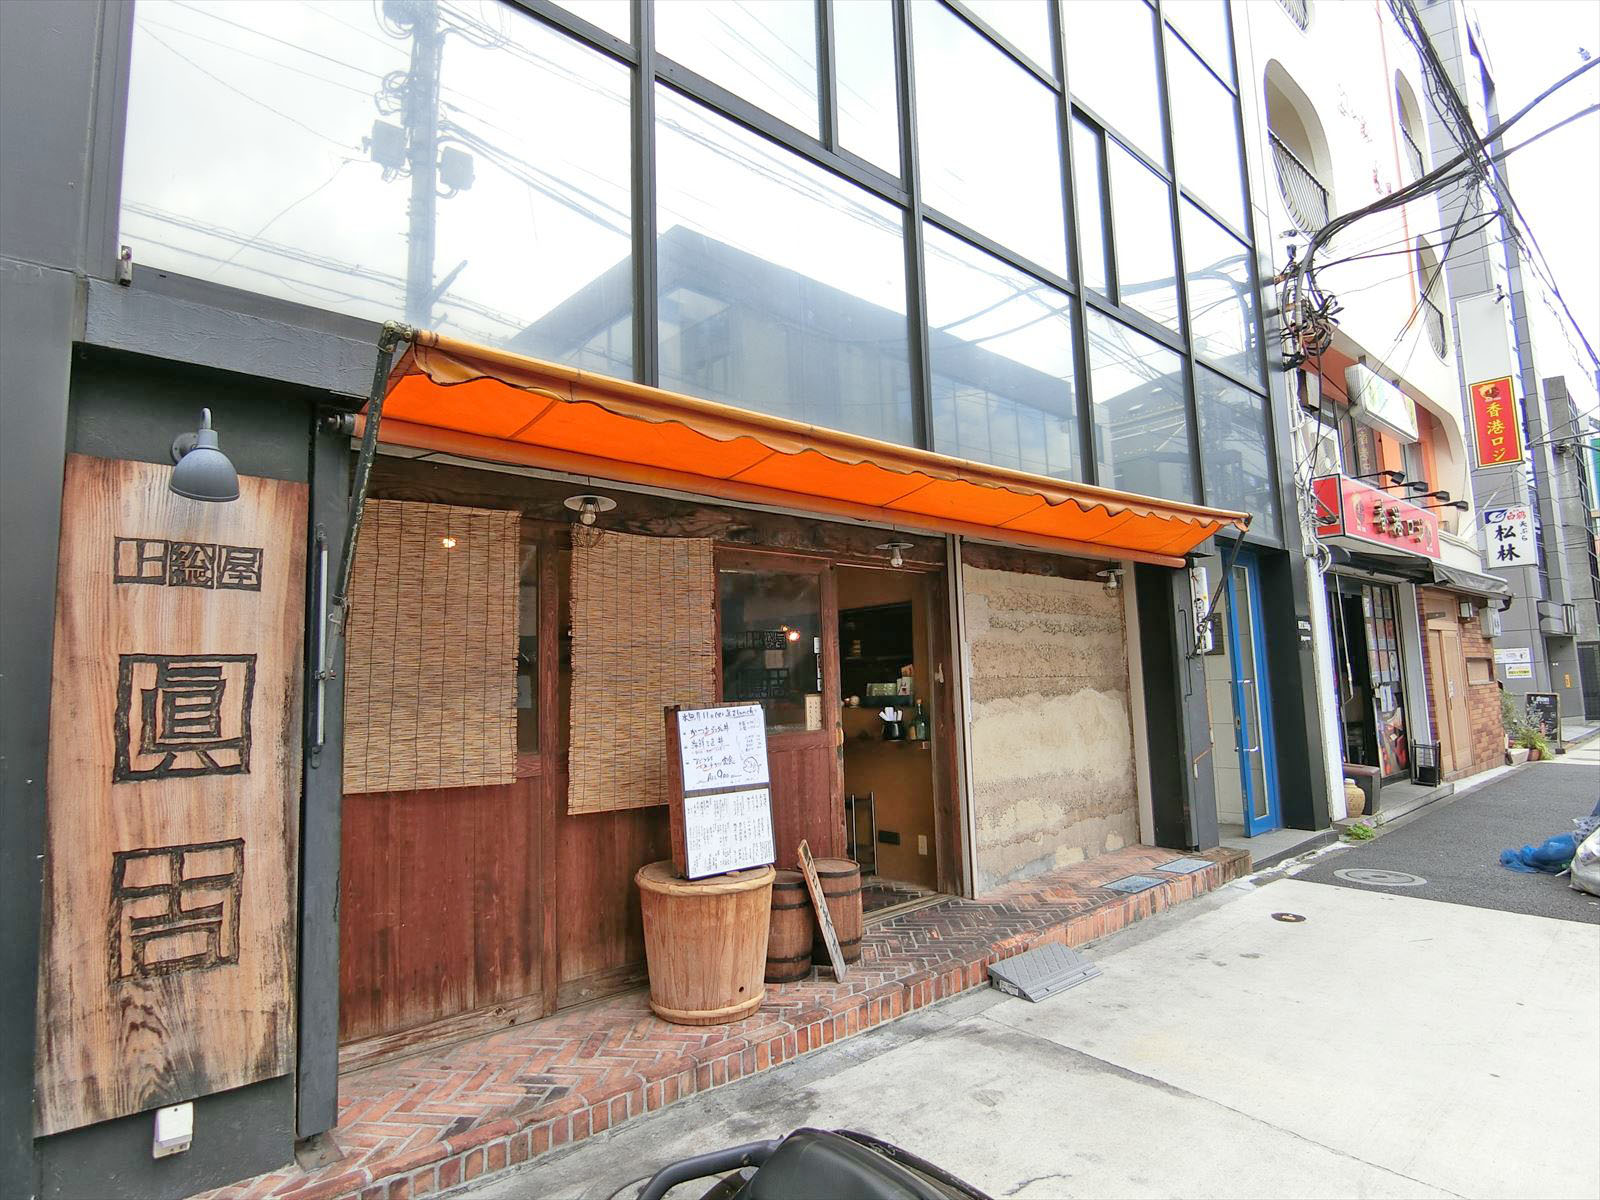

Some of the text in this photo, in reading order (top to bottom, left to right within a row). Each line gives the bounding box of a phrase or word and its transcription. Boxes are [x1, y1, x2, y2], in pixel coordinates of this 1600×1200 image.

[1486, 402, 1506, 462] 香港ロジ
[1494, 525, 1521, 562] 松林
[1519, 520, 1528, 542] 天ぷら
